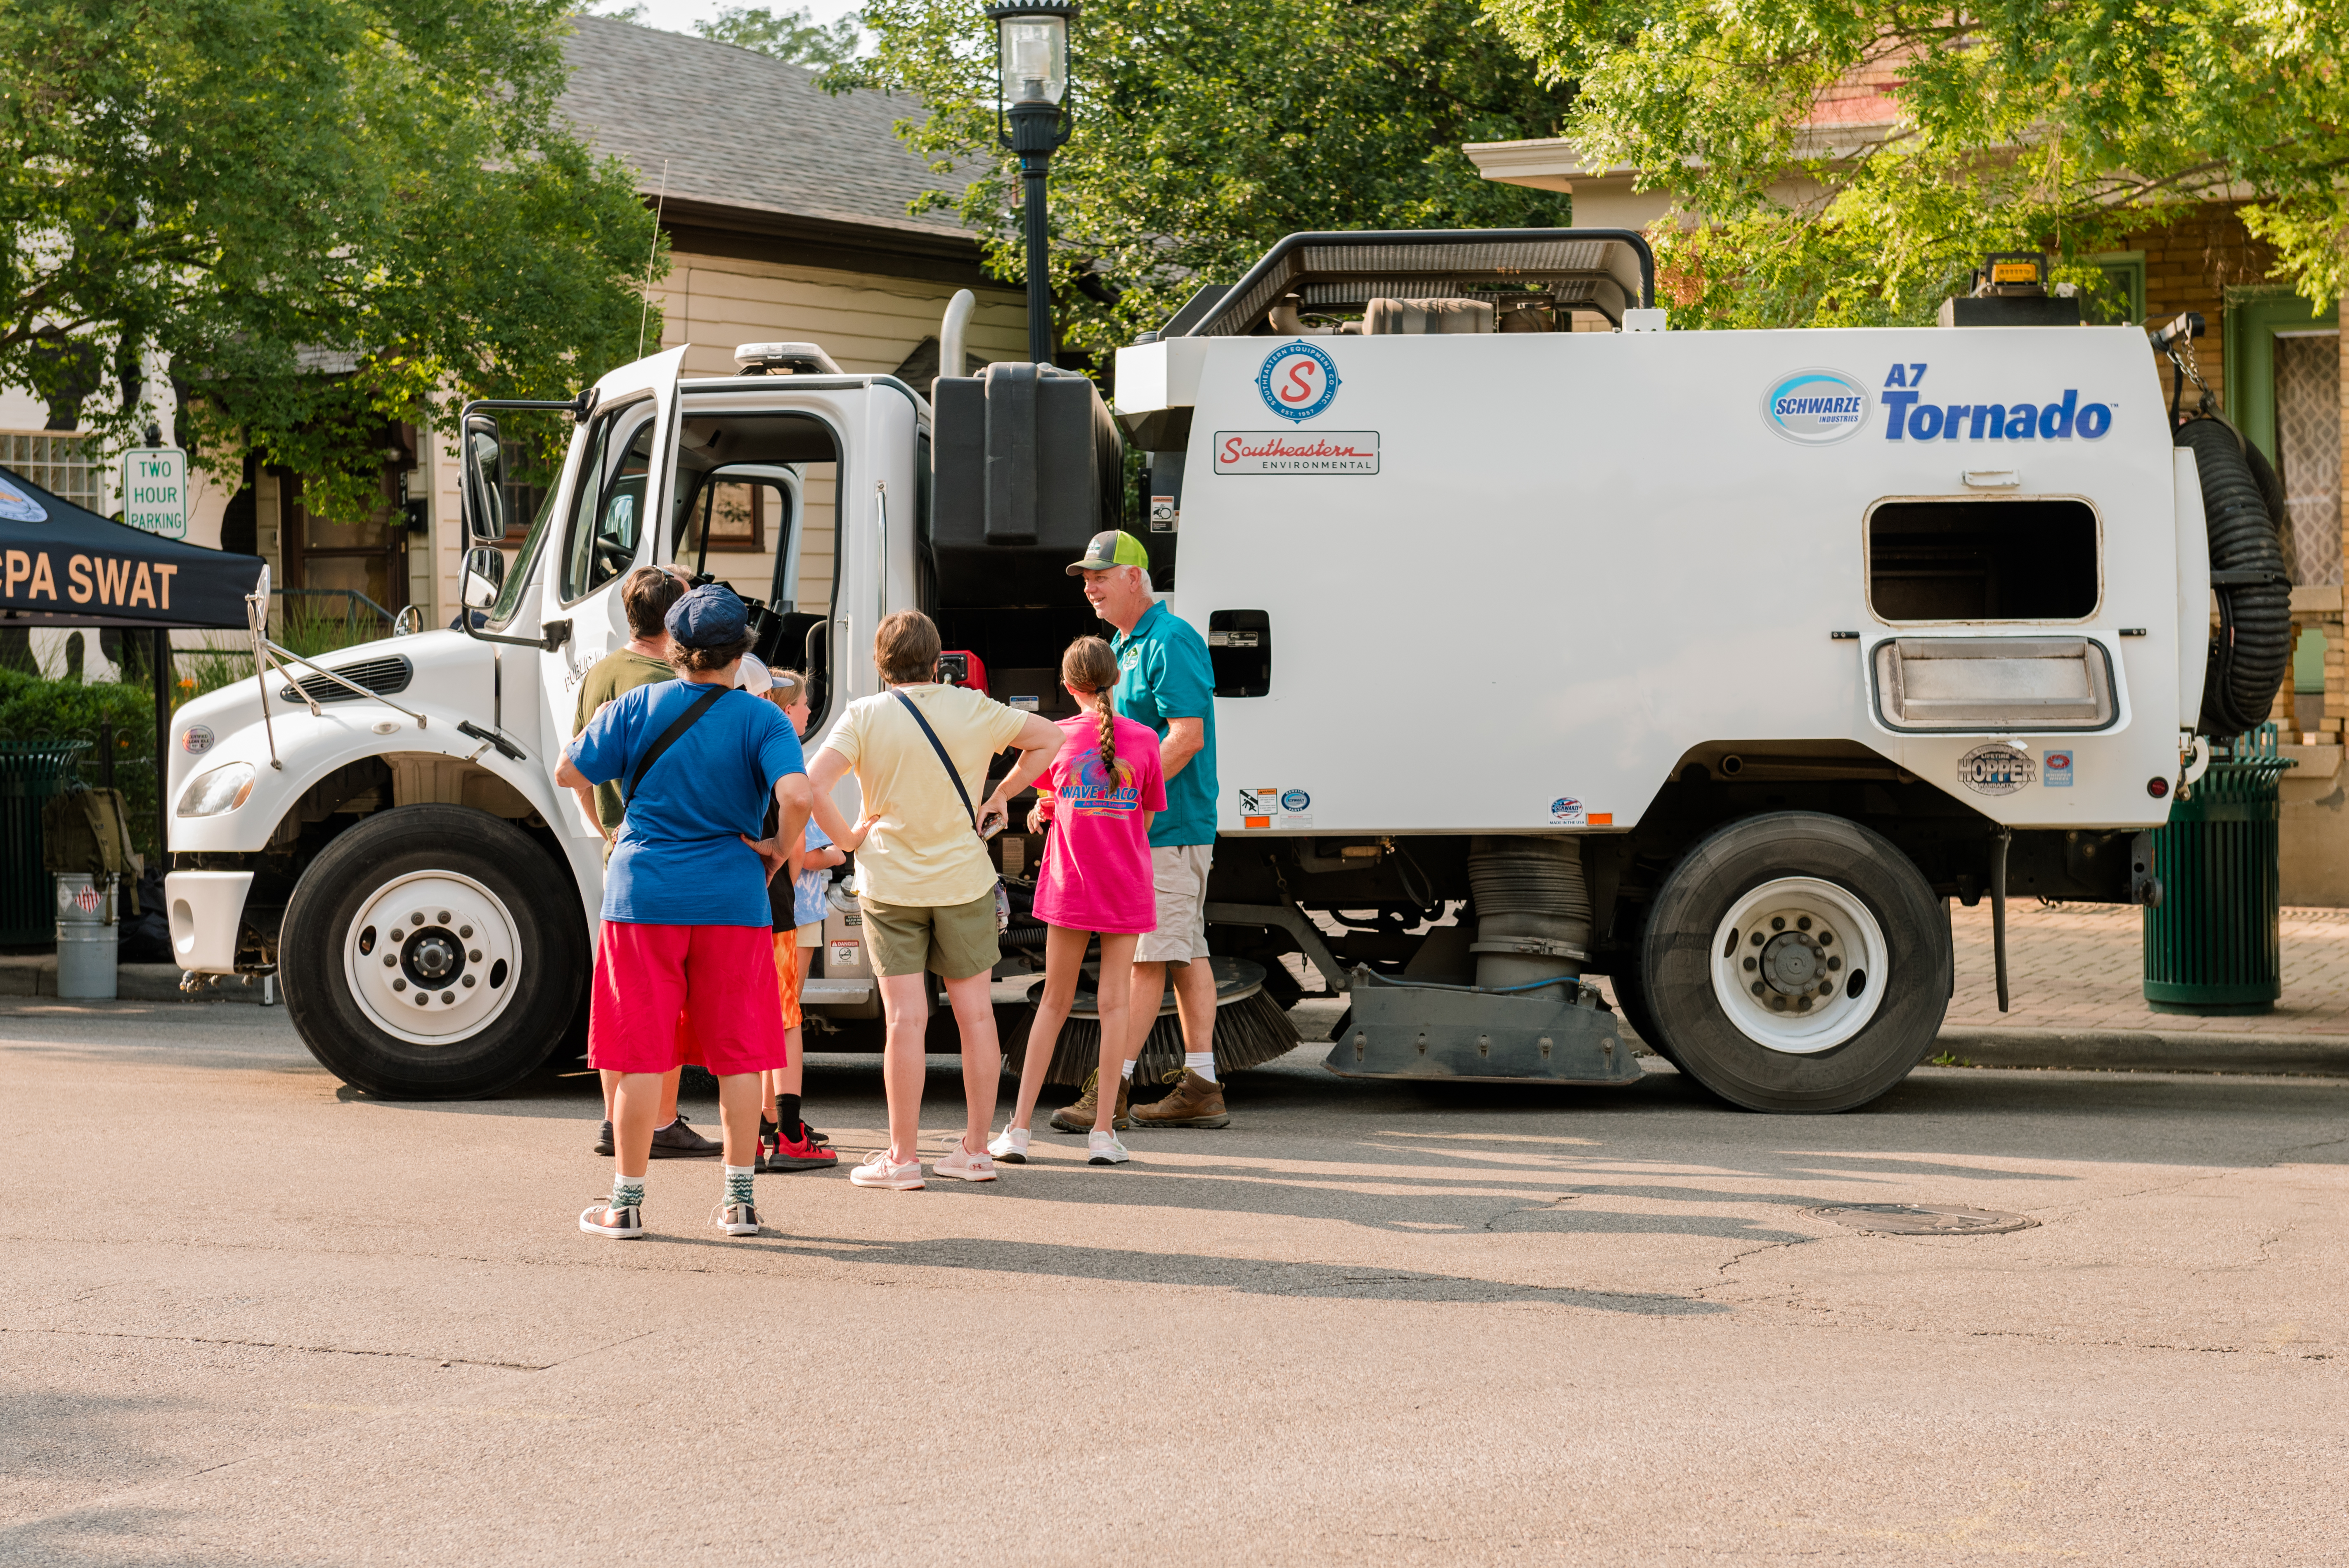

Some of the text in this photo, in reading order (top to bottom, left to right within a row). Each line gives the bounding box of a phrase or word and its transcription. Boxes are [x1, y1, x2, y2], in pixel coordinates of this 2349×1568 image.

[1262, 349, 1287, 406] SOUTHEASTERN
[1290, 346, 1332, 370] EQUIPMENT
[1281, 361, 1315, 402] S
[1883, 364, 1927, 387] A7
[1280, 408, 1296, 417] EST.
[1776, 396, 1861, 415] SCHWARZE
[1881, 389, 2112, 440] Tornado
[1819, 415, 1859, 423] INDUSTRIES
[1220, 437, 1374, 464] Southeastern
[139, 461, 171, 478] TWO
[135, 487, 177, 503] HOUR
[131, 512, 182, 530] PARKING
[0, 549, 178, 610] PA SWAT
[565, 652, 593, 693] PUBLIC
[1957, 758, 2037, 782] HOPPER
[1060, 785, 1139, 801] WAVE TACO
